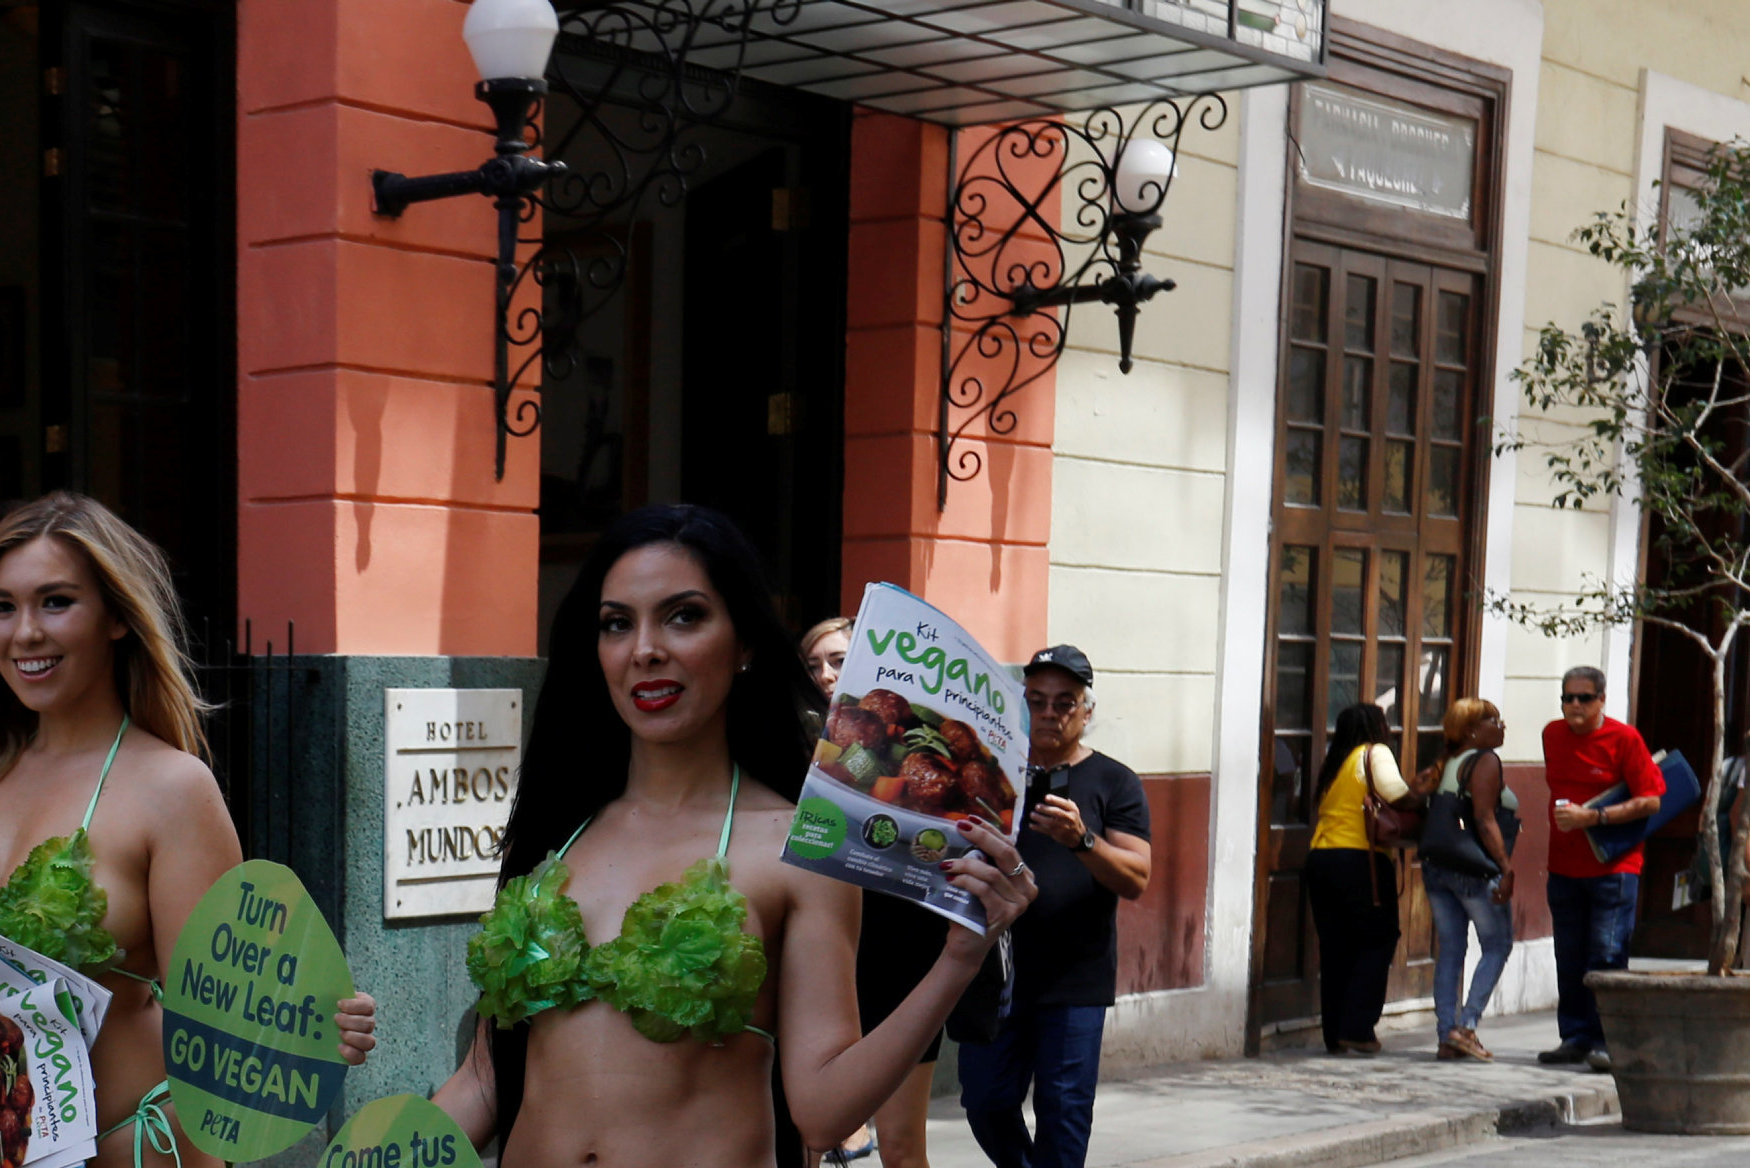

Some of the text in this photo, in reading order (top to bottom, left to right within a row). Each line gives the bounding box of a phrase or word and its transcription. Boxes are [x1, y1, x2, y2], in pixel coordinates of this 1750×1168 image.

[916, 621, 940, 642] Kit
[866, 628, 1006, 715] vegano
[875, 666, 915, 685] para
[426, 721, 488, 742] HOTEL
[407, 765, 510, 807] AMBOS
[236, 881, 288, 935] Turn
[211, 922, 298, 987] Over a
[49, 1018, 68, 1036] Kit
[181, 958, 324, 1041] New Leaf:
[13, 1013, 37, 1039] para
[36, 1062, 60, 1143] principiantes
[20, 991, 78, 1123] vegano
[170, 1029, 320, 1109] GO VEGAN
